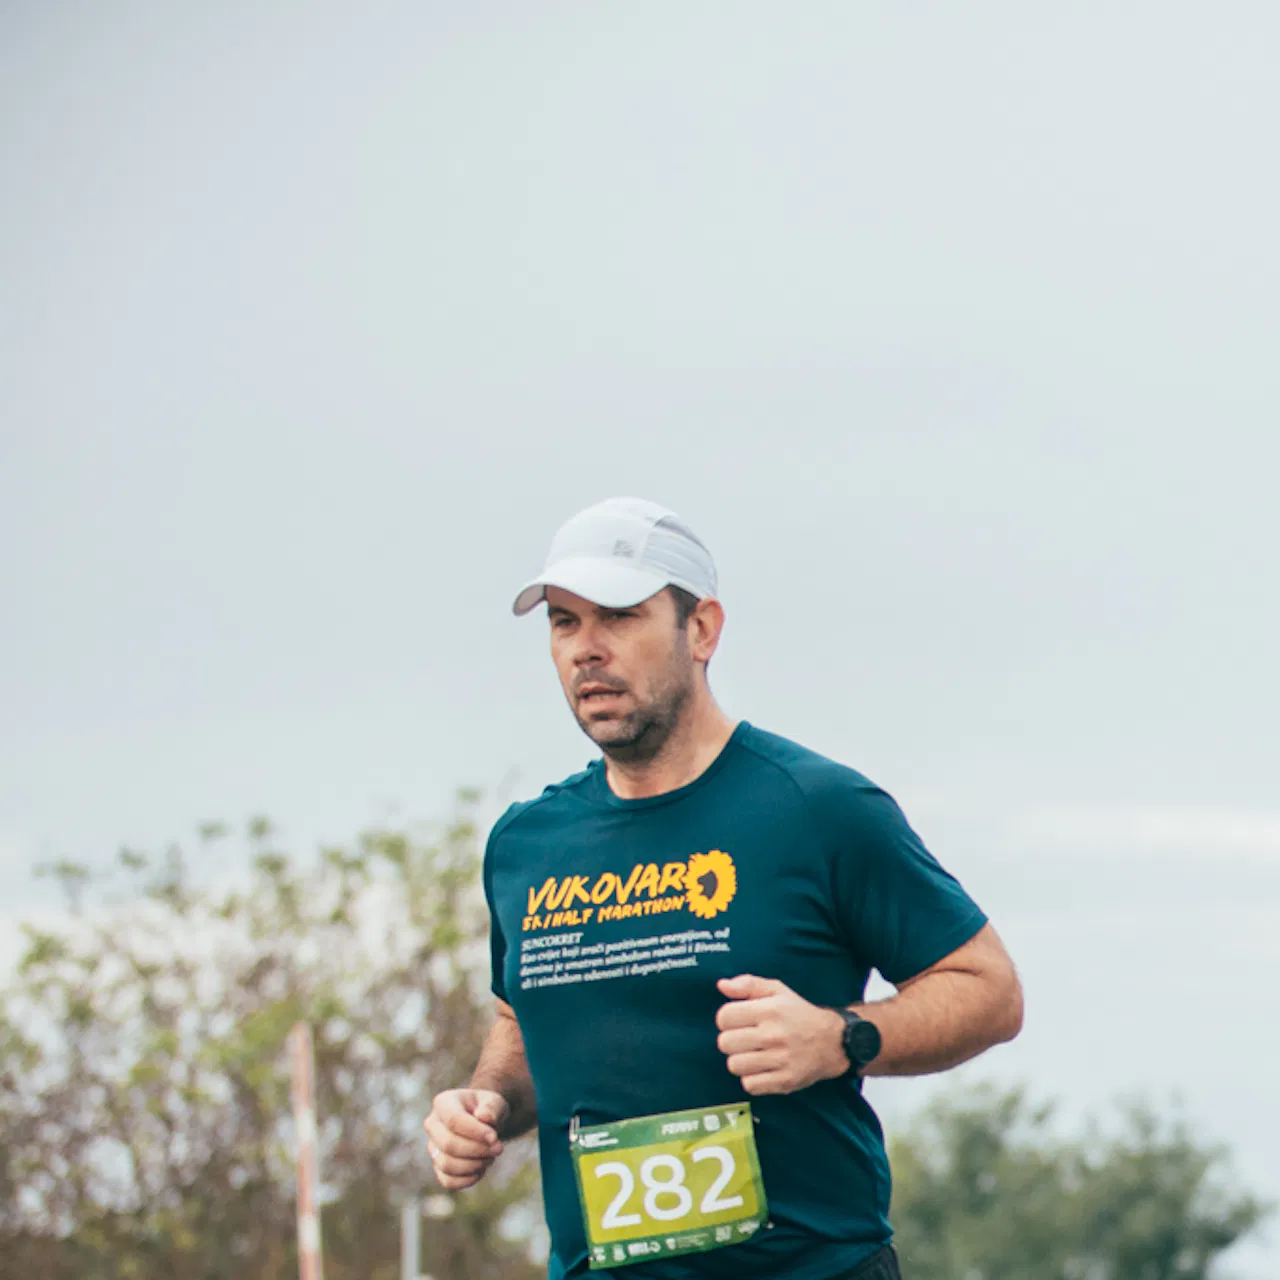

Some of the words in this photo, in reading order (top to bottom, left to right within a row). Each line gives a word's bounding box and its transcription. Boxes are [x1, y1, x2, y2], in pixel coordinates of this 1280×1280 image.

[527, 862, 687, 916] VUKOVAR
[597, 895, 686, 923] MARATHON
[594, 1146, 744, 1230] 282
